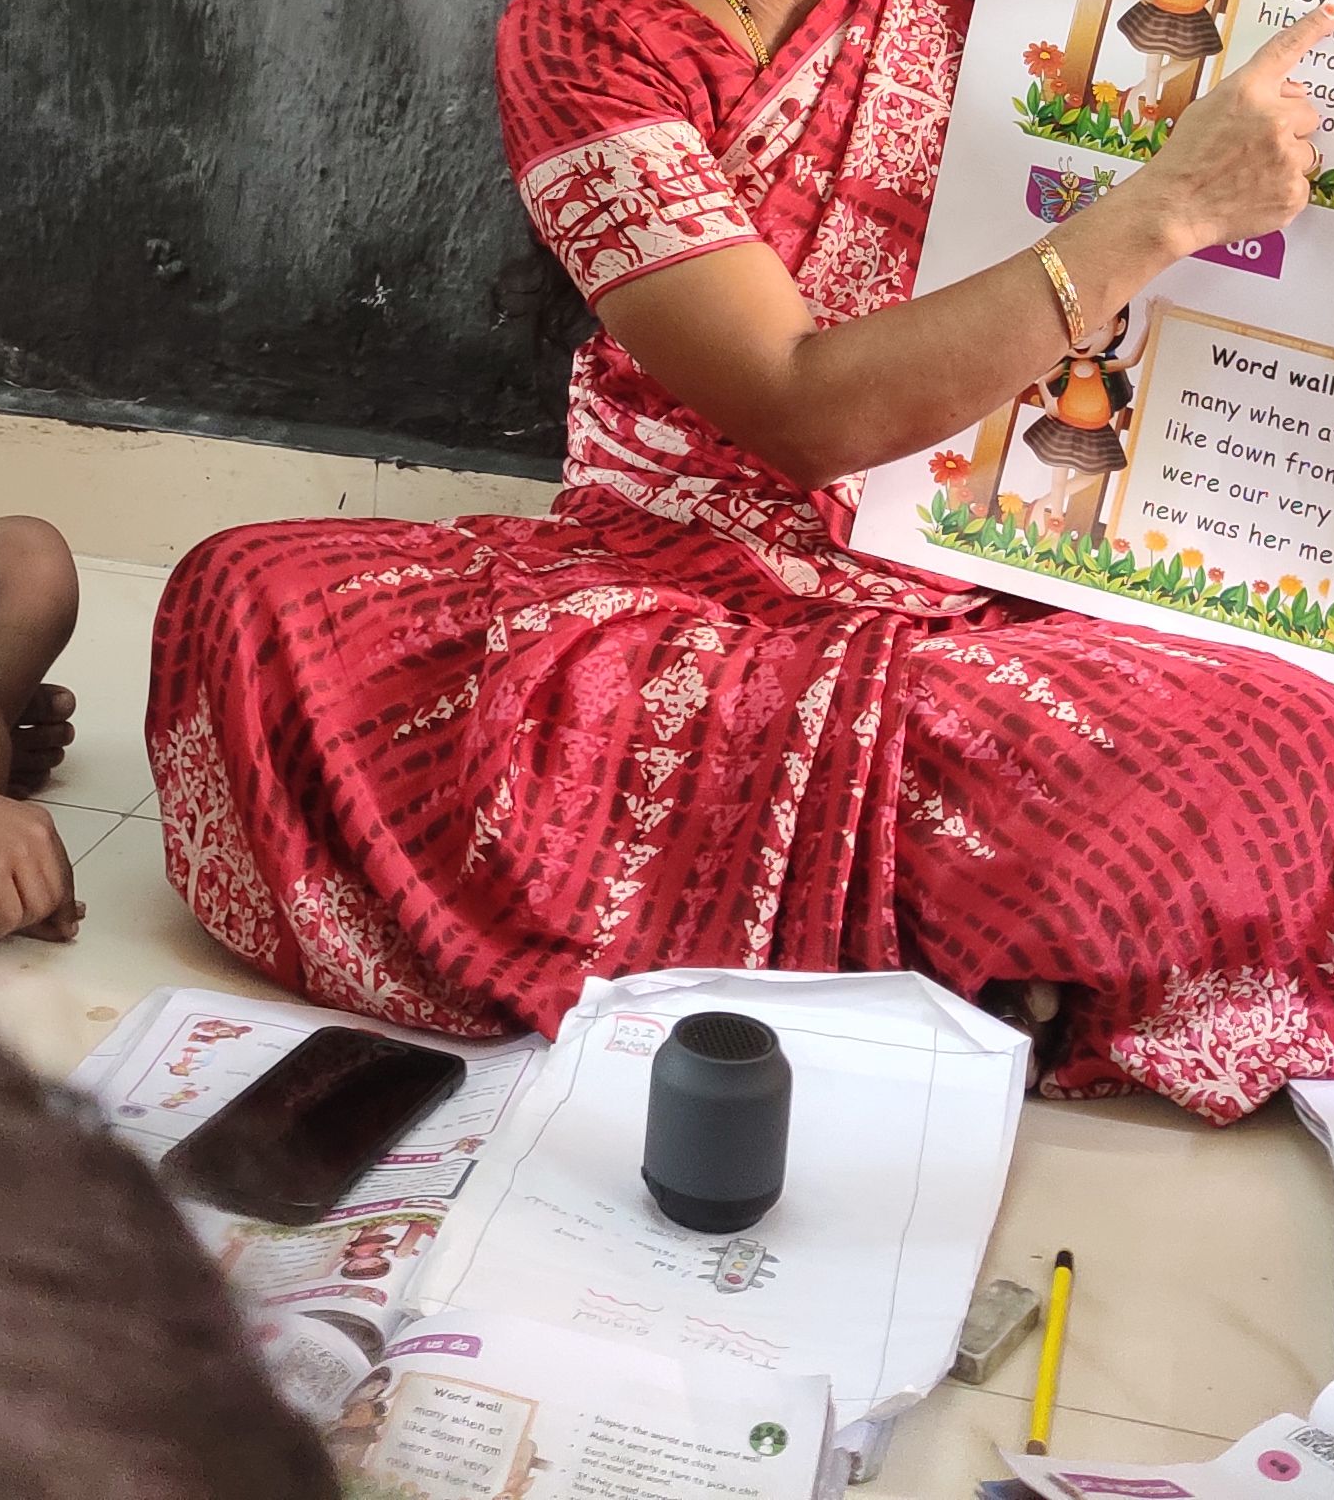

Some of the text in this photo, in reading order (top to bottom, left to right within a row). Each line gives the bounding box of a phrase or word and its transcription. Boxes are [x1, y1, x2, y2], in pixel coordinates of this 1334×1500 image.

[1211, 344, 1279, 380] Word
[1180, 389, 1241, 422] many
[1250, 406, 1310, 437] when
[1165, 418, 1208, 449] like
[1216, 434, 1276, 467] down
[1162, 464, 1332, 528] were our very
[1142, 500, 1334, 564] new was her me
[434, 1386, 504, 1414] Word wall
